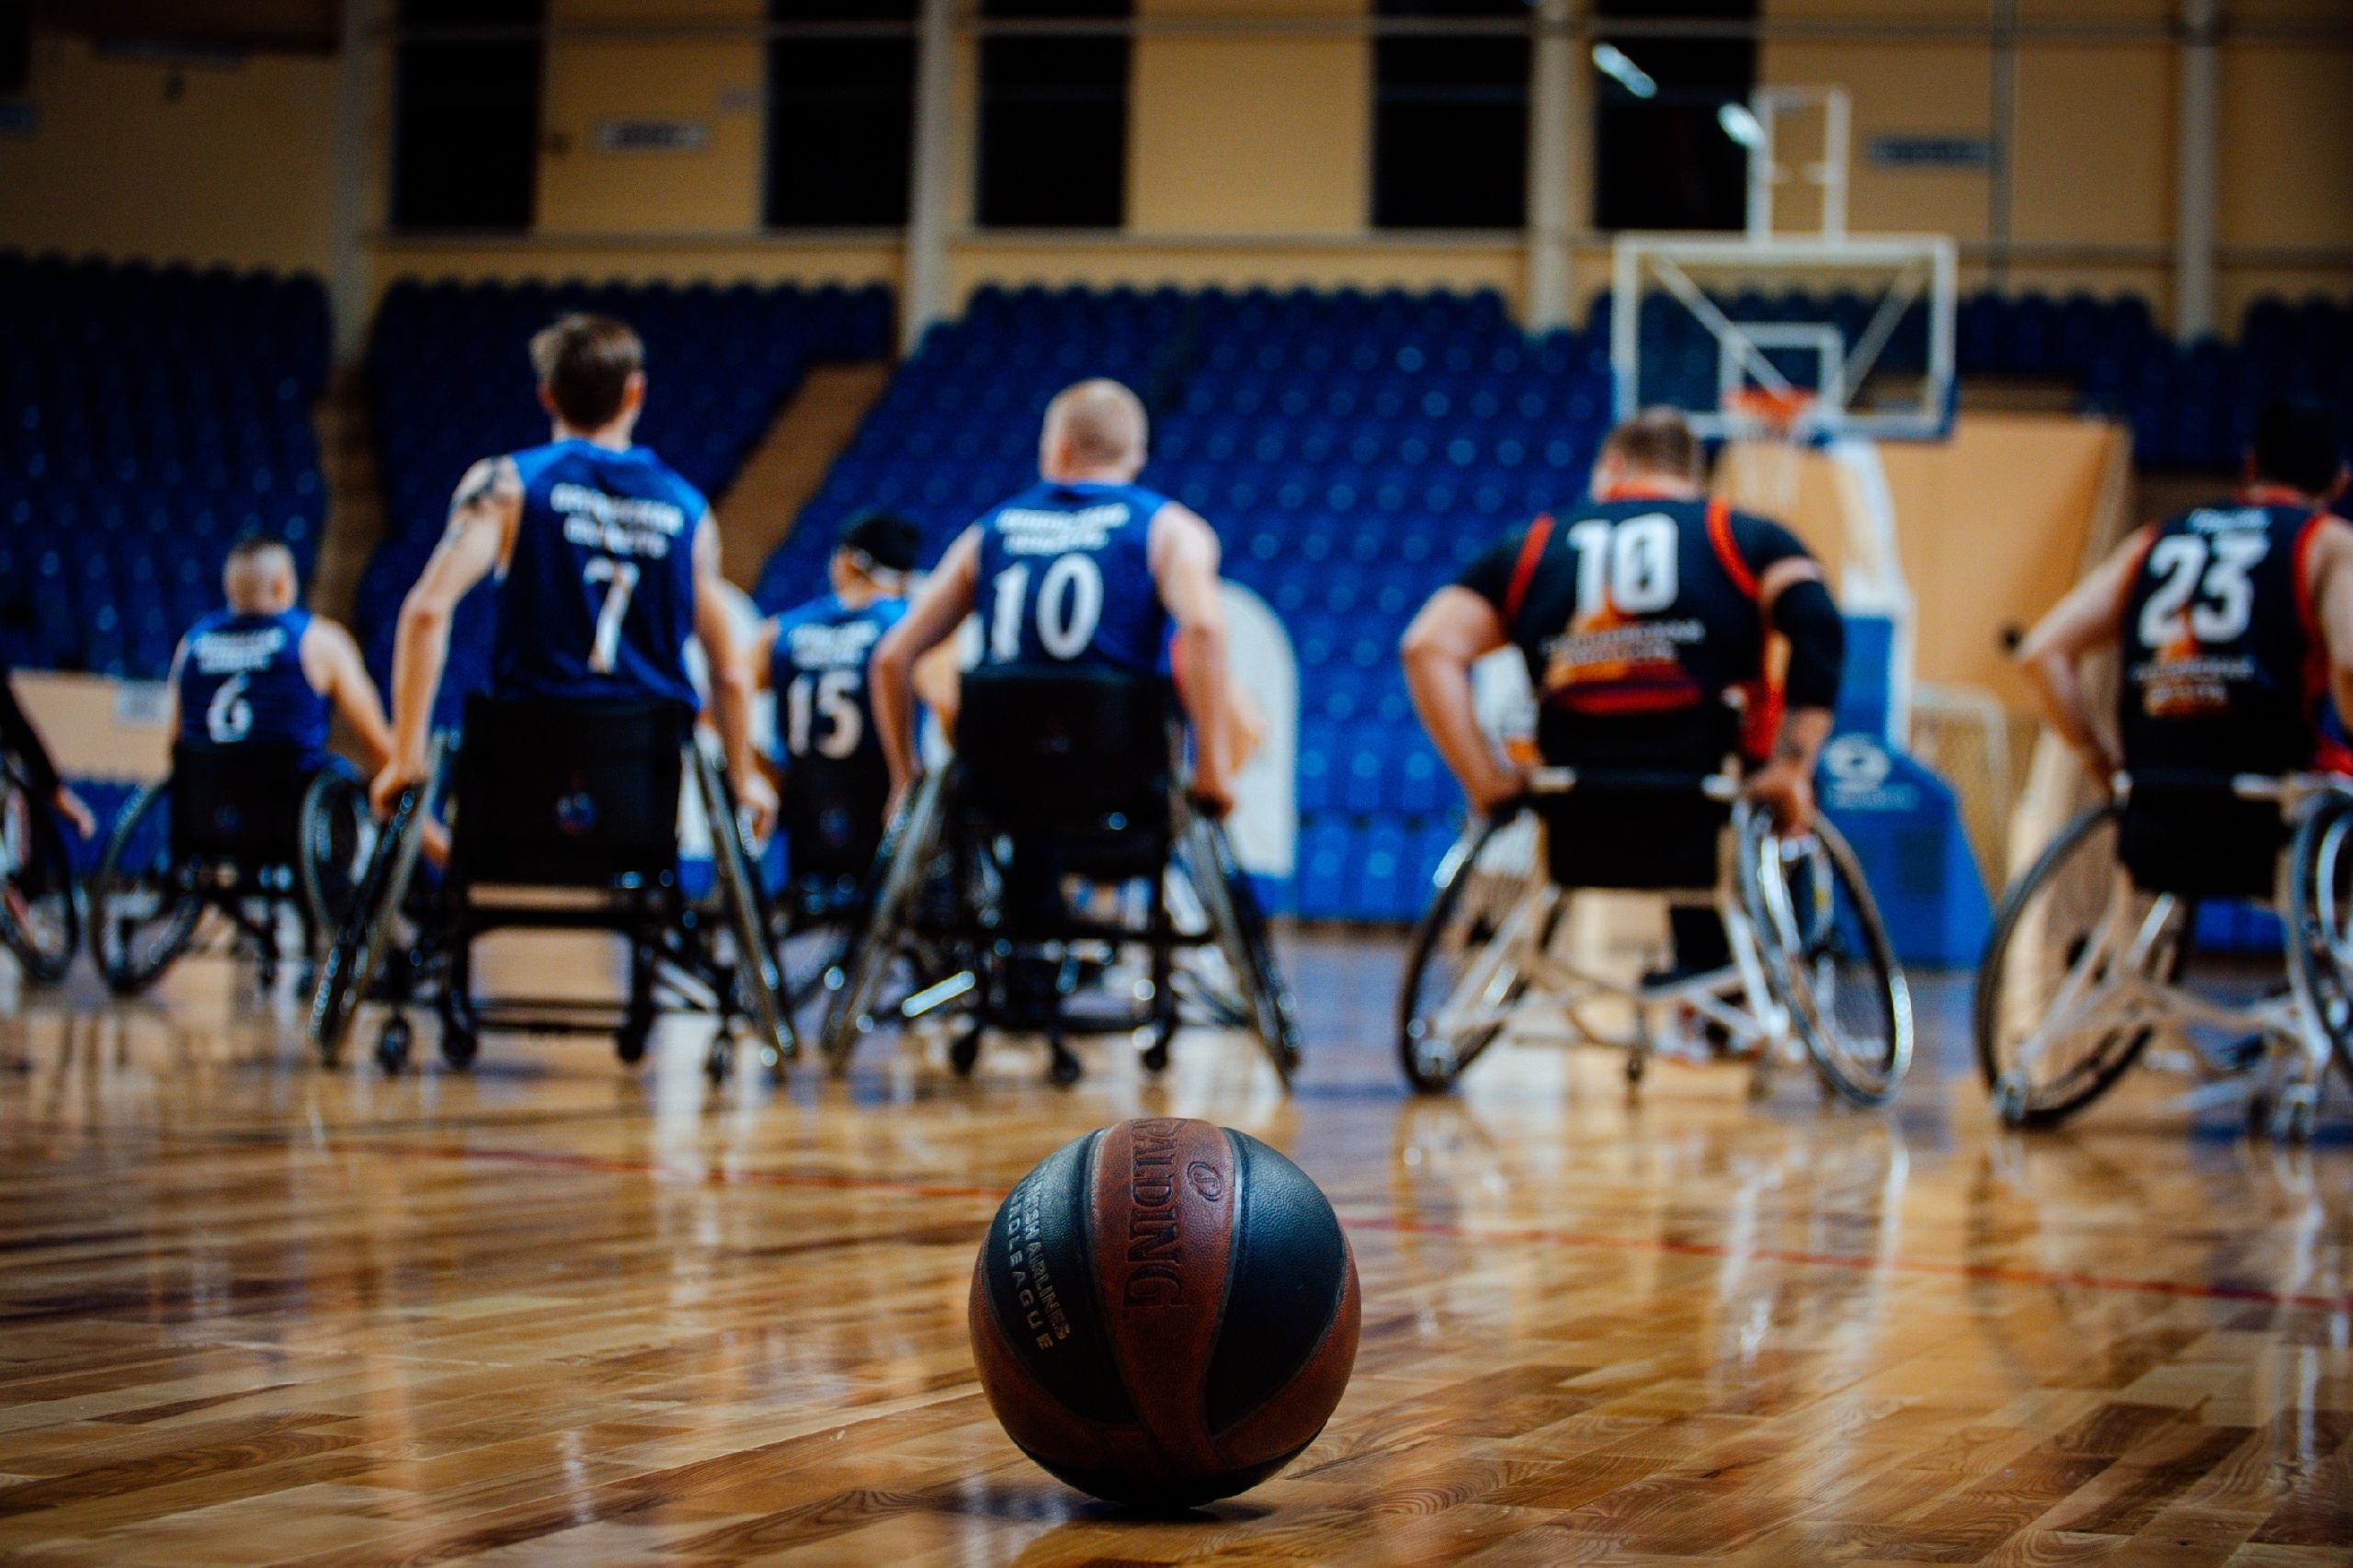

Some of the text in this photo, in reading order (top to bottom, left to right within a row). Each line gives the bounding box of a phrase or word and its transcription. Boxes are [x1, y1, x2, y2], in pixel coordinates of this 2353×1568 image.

[583, 558, 642, 674] 7
[992, 552, 1104, 663] 10
[1567, 512, 1679, 615] 10
[2139, 533, 2271, 648] 23
[207, 673, 255, 744] 6
[788, 671, 863, 760] 15
[1007, 1176, 1054, 1350] UROLEAGUE
[1027, 1242, 1072, 1340] AIRLINES
